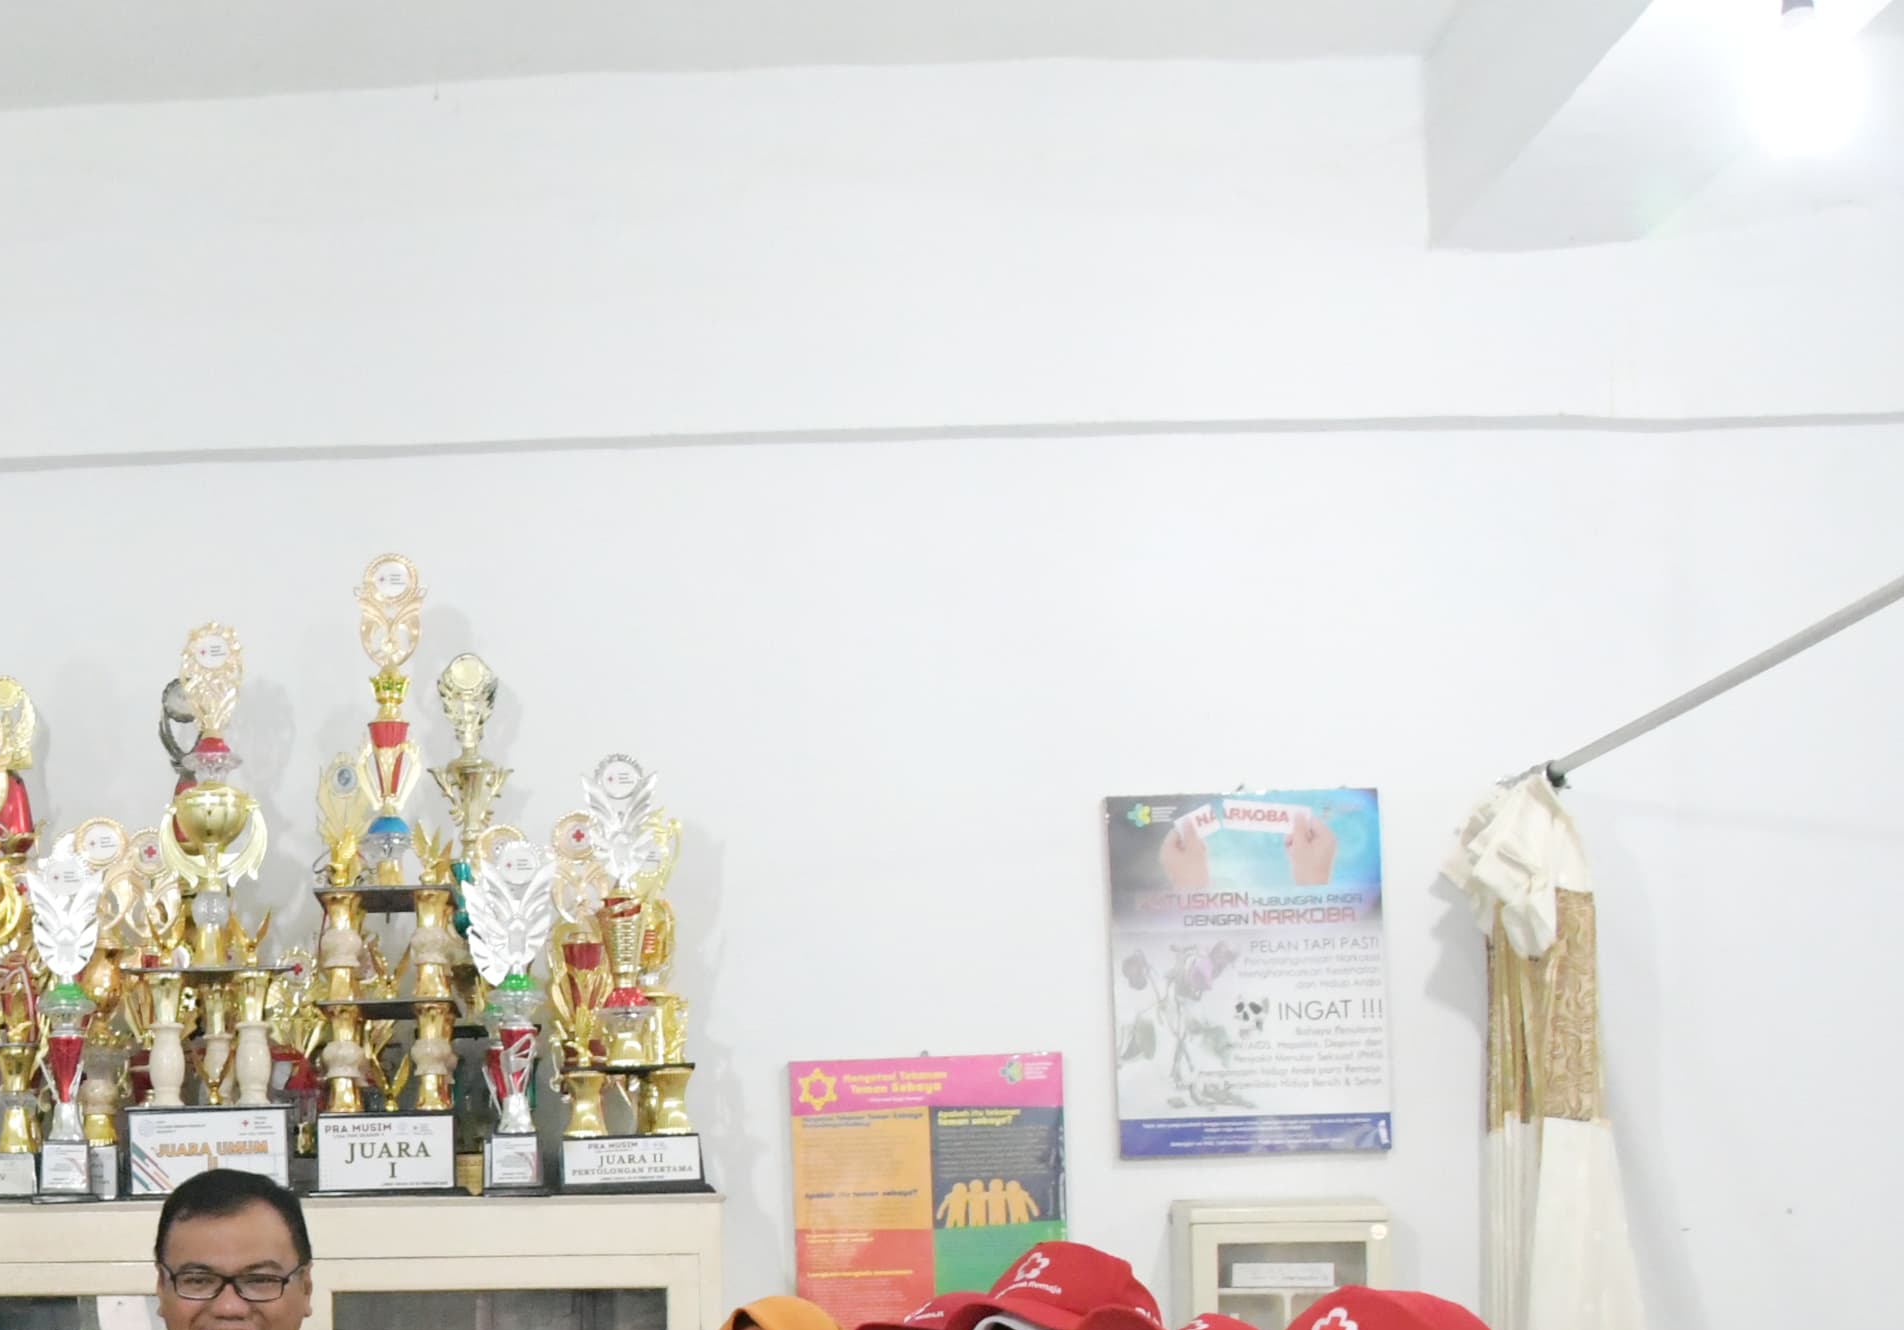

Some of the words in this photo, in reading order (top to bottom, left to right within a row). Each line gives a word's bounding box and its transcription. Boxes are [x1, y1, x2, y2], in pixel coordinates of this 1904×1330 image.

[1251, 894, 1323, 907] HUBUNGAN
[1184, 914, 1249, 927] DENGAN
[1252, 907, 1356, 925] NARKOBA
[1250, 939, 1298, 953] PELAN
[1304, 938, 1335, 951] TAPI
[1340, 936, 1380, 950] PASTI
[1278, 999, 1353, 1021] INGAT
[1361, 998, 1383, 1020] !!!
[324, 1124, 348, 1134] PRA
[352, 1122, 392, 1133] MUSIM
[157, 1142, 212, 1157] JUARA
[216, 1140, 269, 1155] UMUM
[345, 1141, 431, 1164] JUARA
[598, 1154, 647, 1167] JUARA
[653, 1153, 664, 1163] II
[389, 1162, 397, 1178] I
[572, 1167, 644, 1176] PERTOLONGAN
[648, 1165, 693, 1173] PERTAMA
